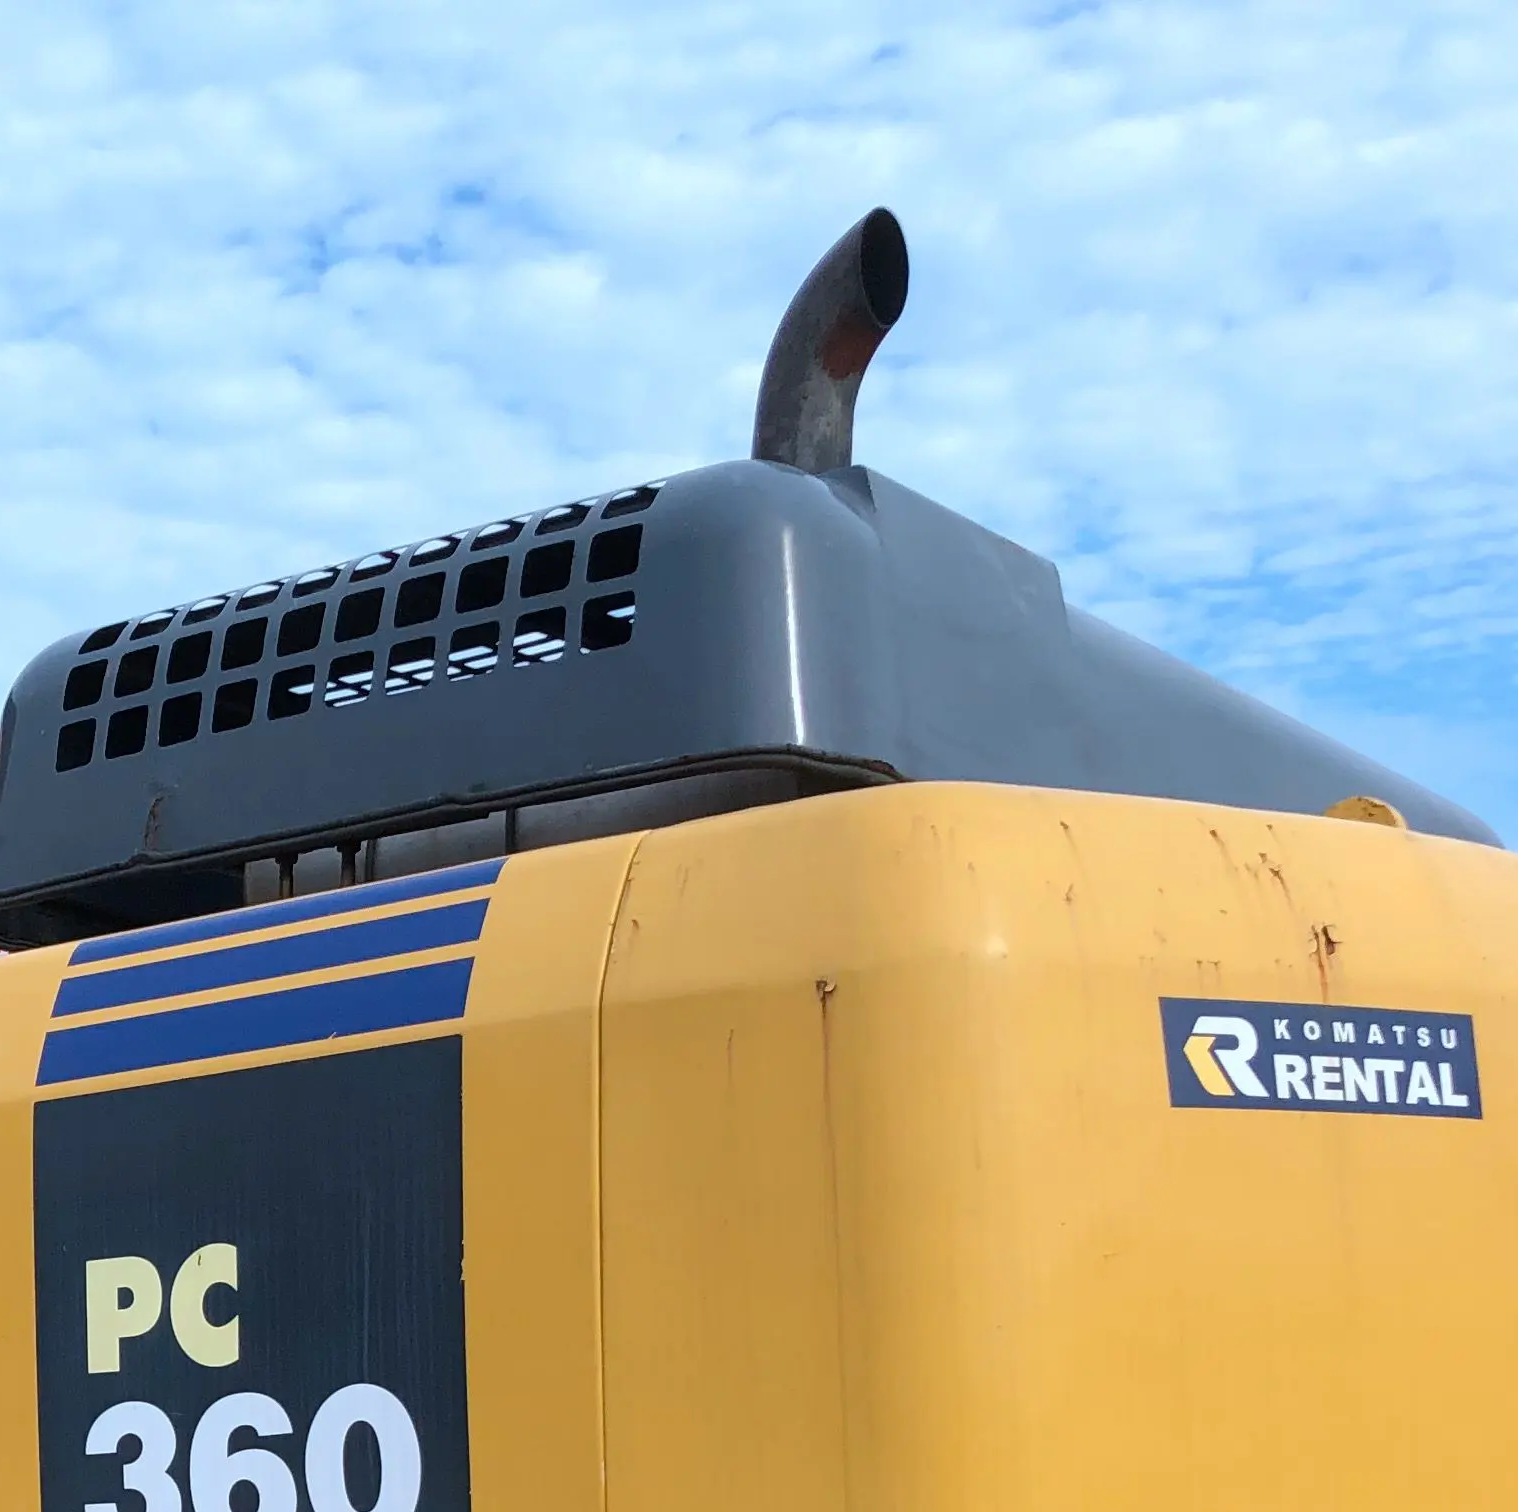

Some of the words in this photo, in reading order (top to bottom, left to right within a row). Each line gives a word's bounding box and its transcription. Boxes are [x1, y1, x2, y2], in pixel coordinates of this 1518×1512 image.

[1273, 1018, 1458, 1050] KOMATSU
[1273, 1053, 1470, 1107] RENTAL
[85, 1242, 241, 1374] PC
